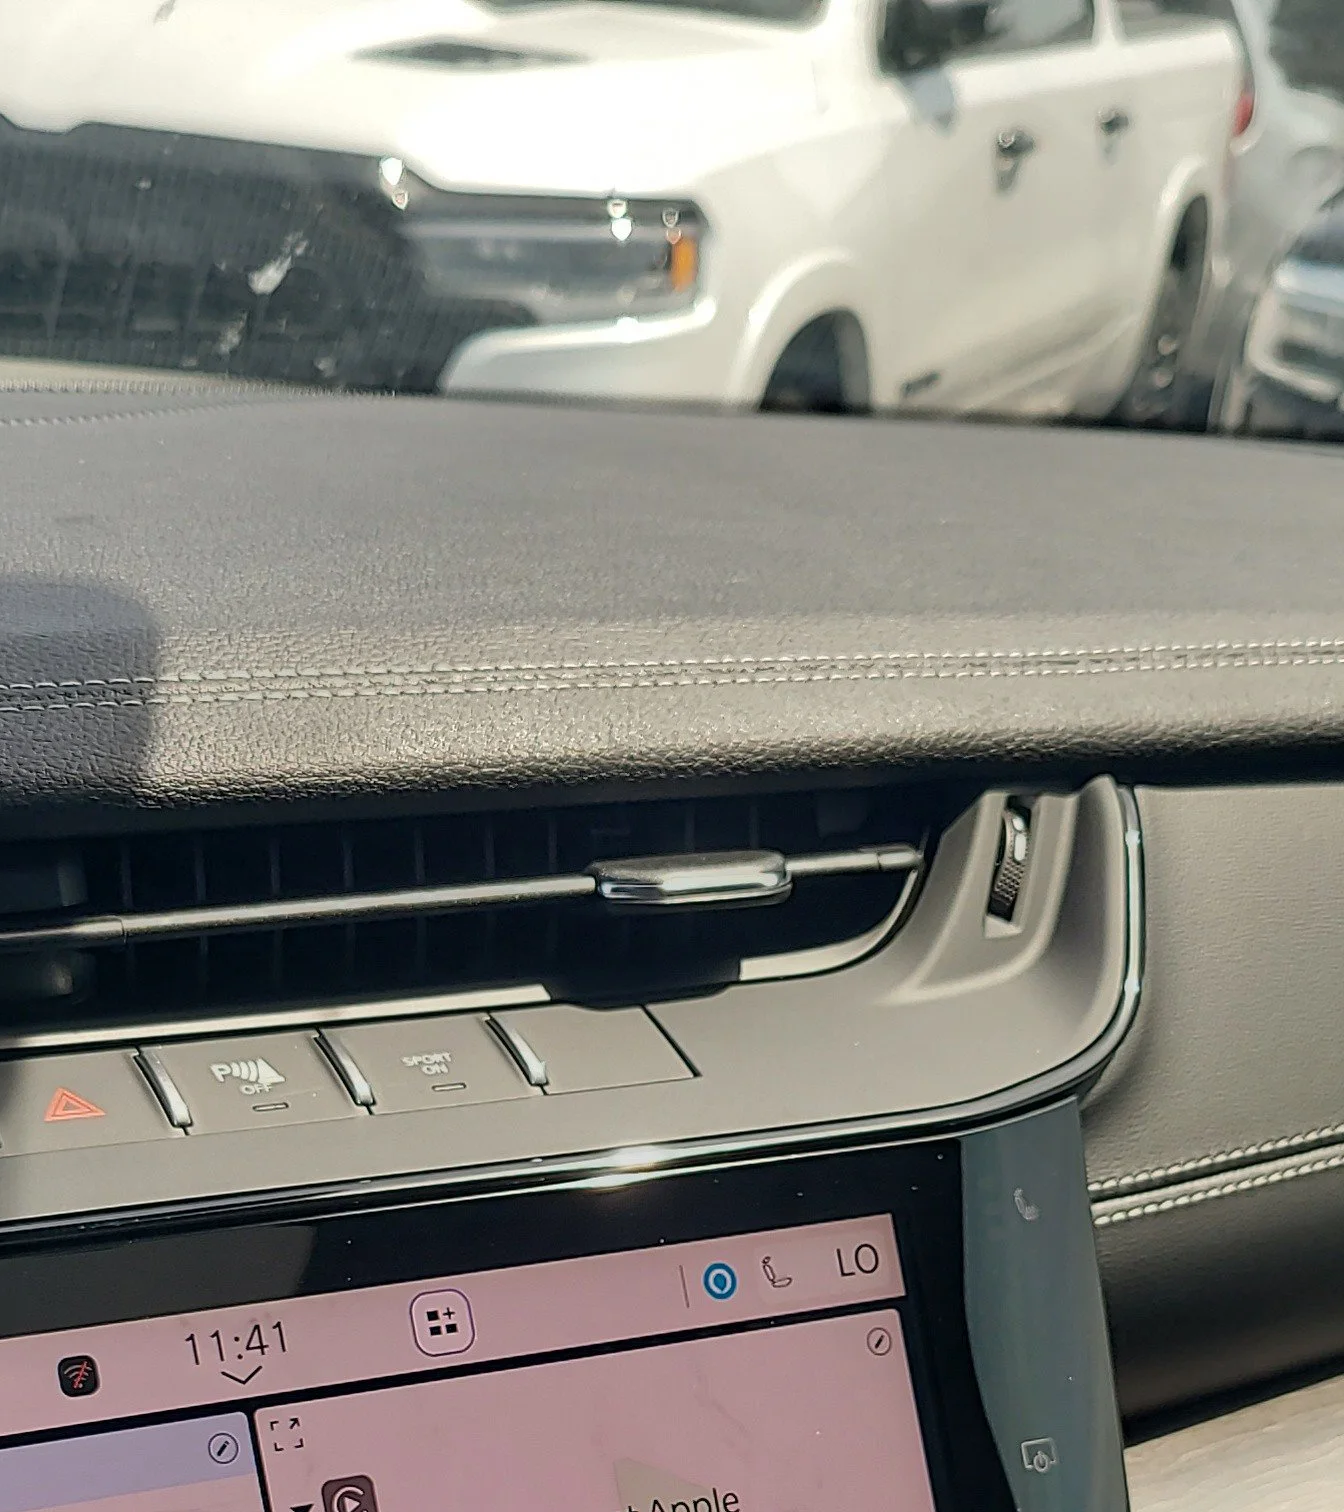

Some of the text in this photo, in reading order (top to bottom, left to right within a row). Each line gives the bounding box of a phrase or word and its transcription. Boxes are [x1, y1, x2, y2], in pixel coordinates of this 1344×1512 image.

[402, 1051, 453, 1070] SPORT
[421, 1062, 449, 1076] ON
[240, 1081, 274, 1096] OFF
[836, 1243, 880, 1278] LO
[184, 1320, 290, 1367] 11:41
